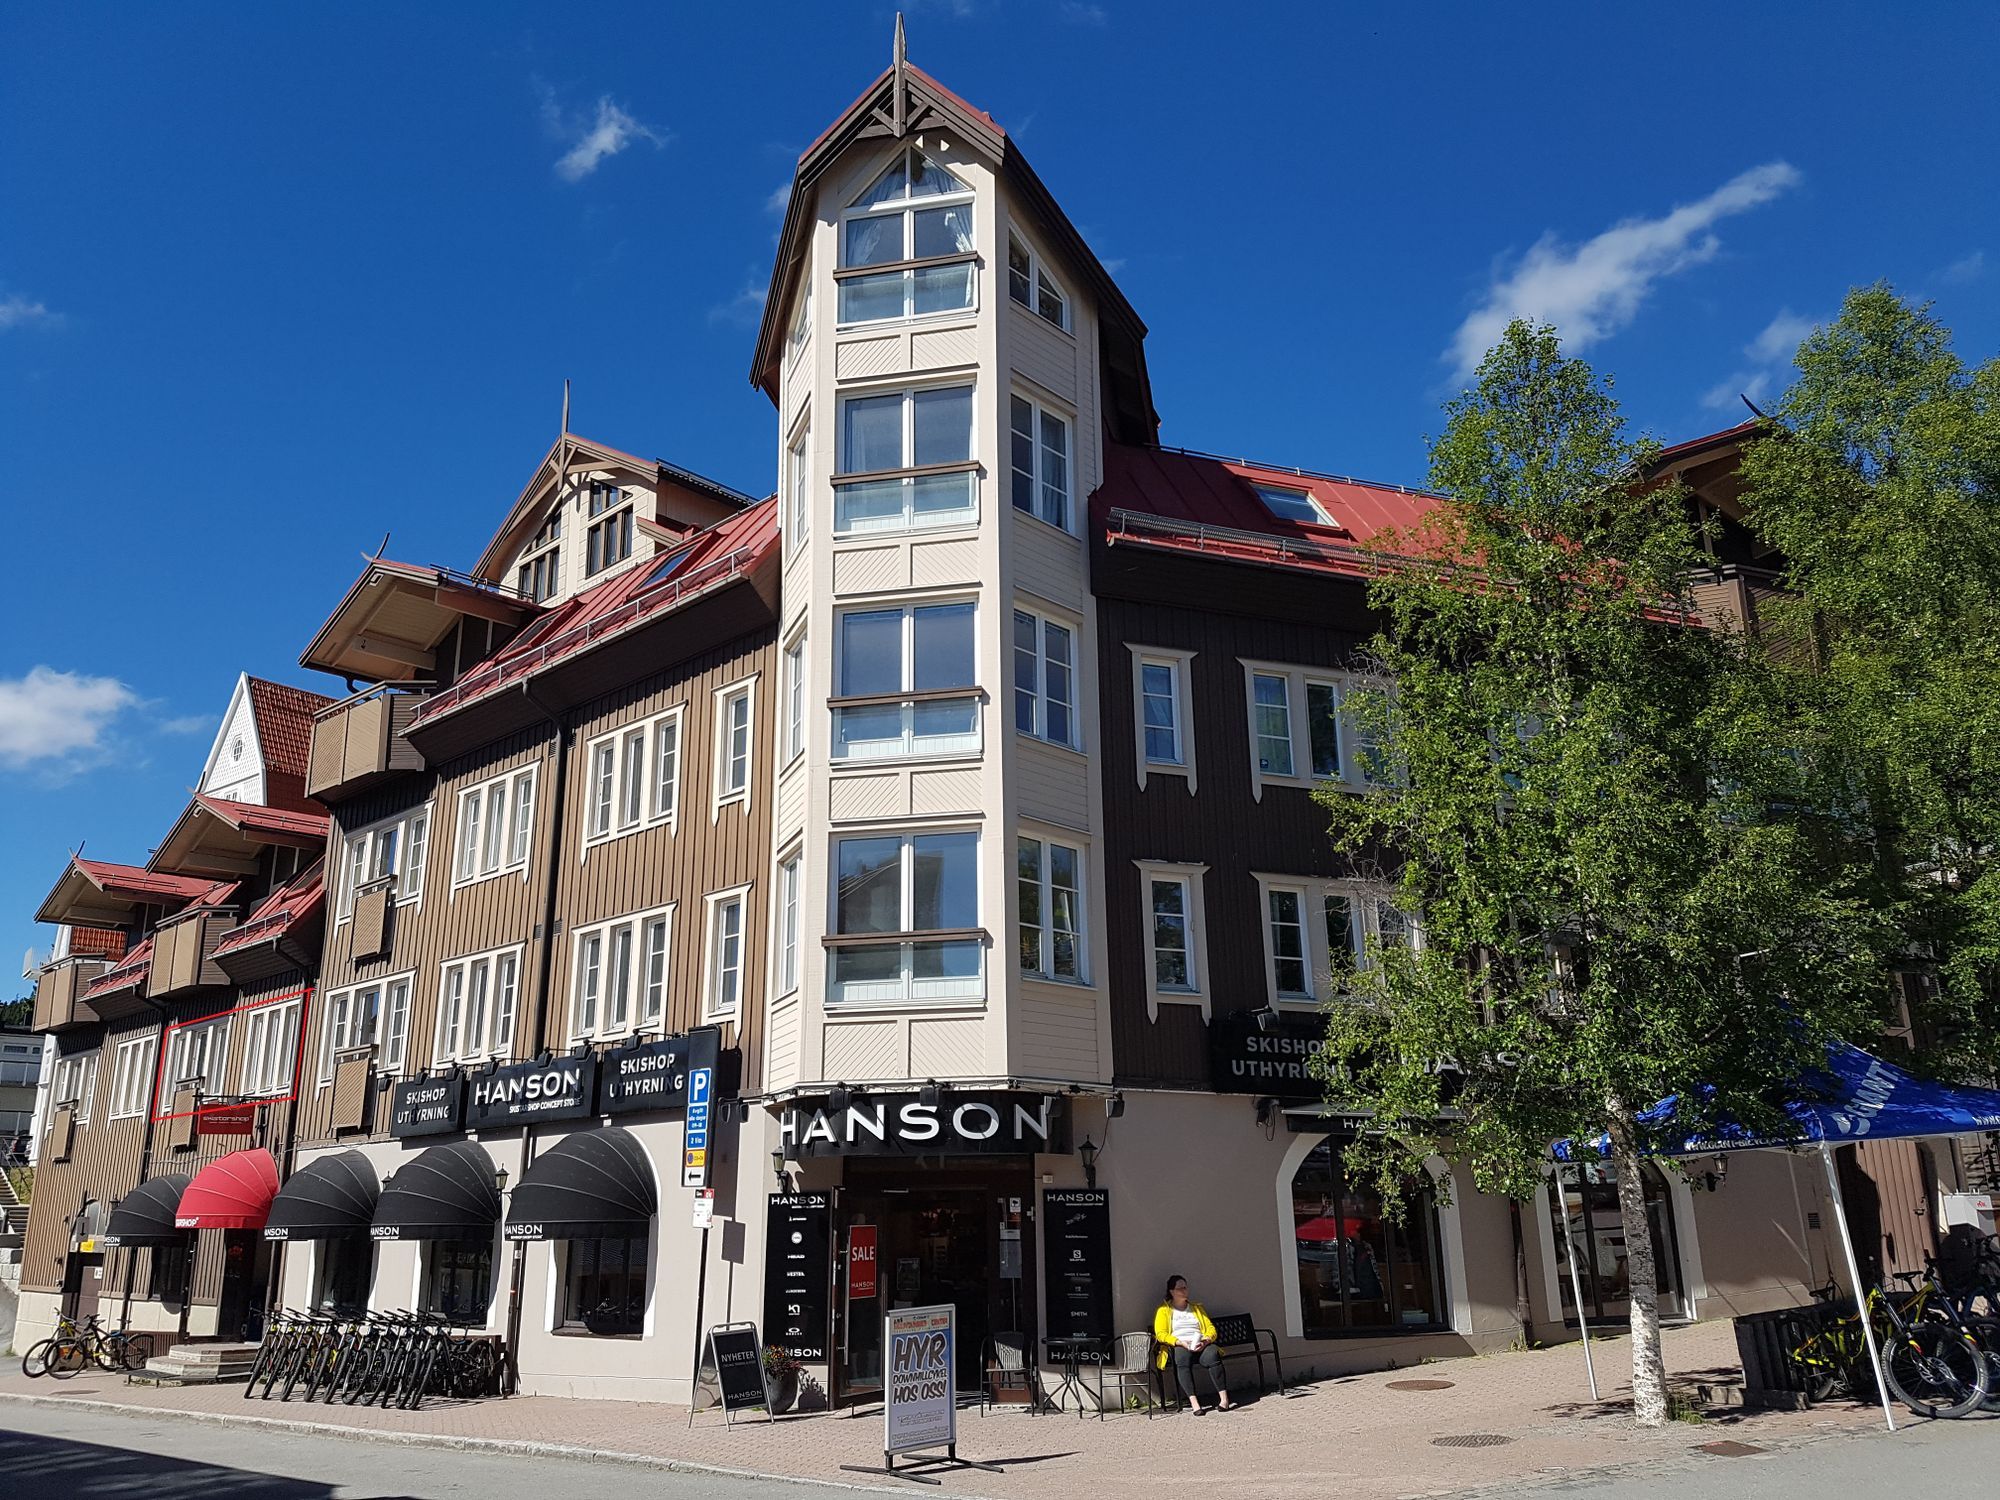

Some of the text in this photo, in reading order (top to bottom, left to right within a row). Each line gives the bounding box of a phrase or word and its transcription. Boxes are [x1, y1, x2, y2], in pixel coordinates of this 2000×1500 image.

[1245, 1035, 1326, 1056] SKISHO
[620, 1053, 675, 1075] SKISHOP
[406, 1087, 447, 1105] SKISHOP
[474, 1068, 581, 1106] HANSON
[693, 1072, 706, 1101] P
[1843, 1060, 1899, 1118] GIANT
[780, 1101, 1048, 1146] HANSON
[771, 1195, 826, 1206] HANSON
[1047, 1193, 1104, 1202] HANSON
[851, 1246, 875, 1262] SALE
[721, 1351, 755, 1363] NYHETER
[893, 1333, 947, 1372] HYR
[892, 1368, 948, 1385] DOWNHILLCYKEL
[727, 1389, 763, 1400] HANSON
[893, 1380, 947, 1405] HOS OSS!
